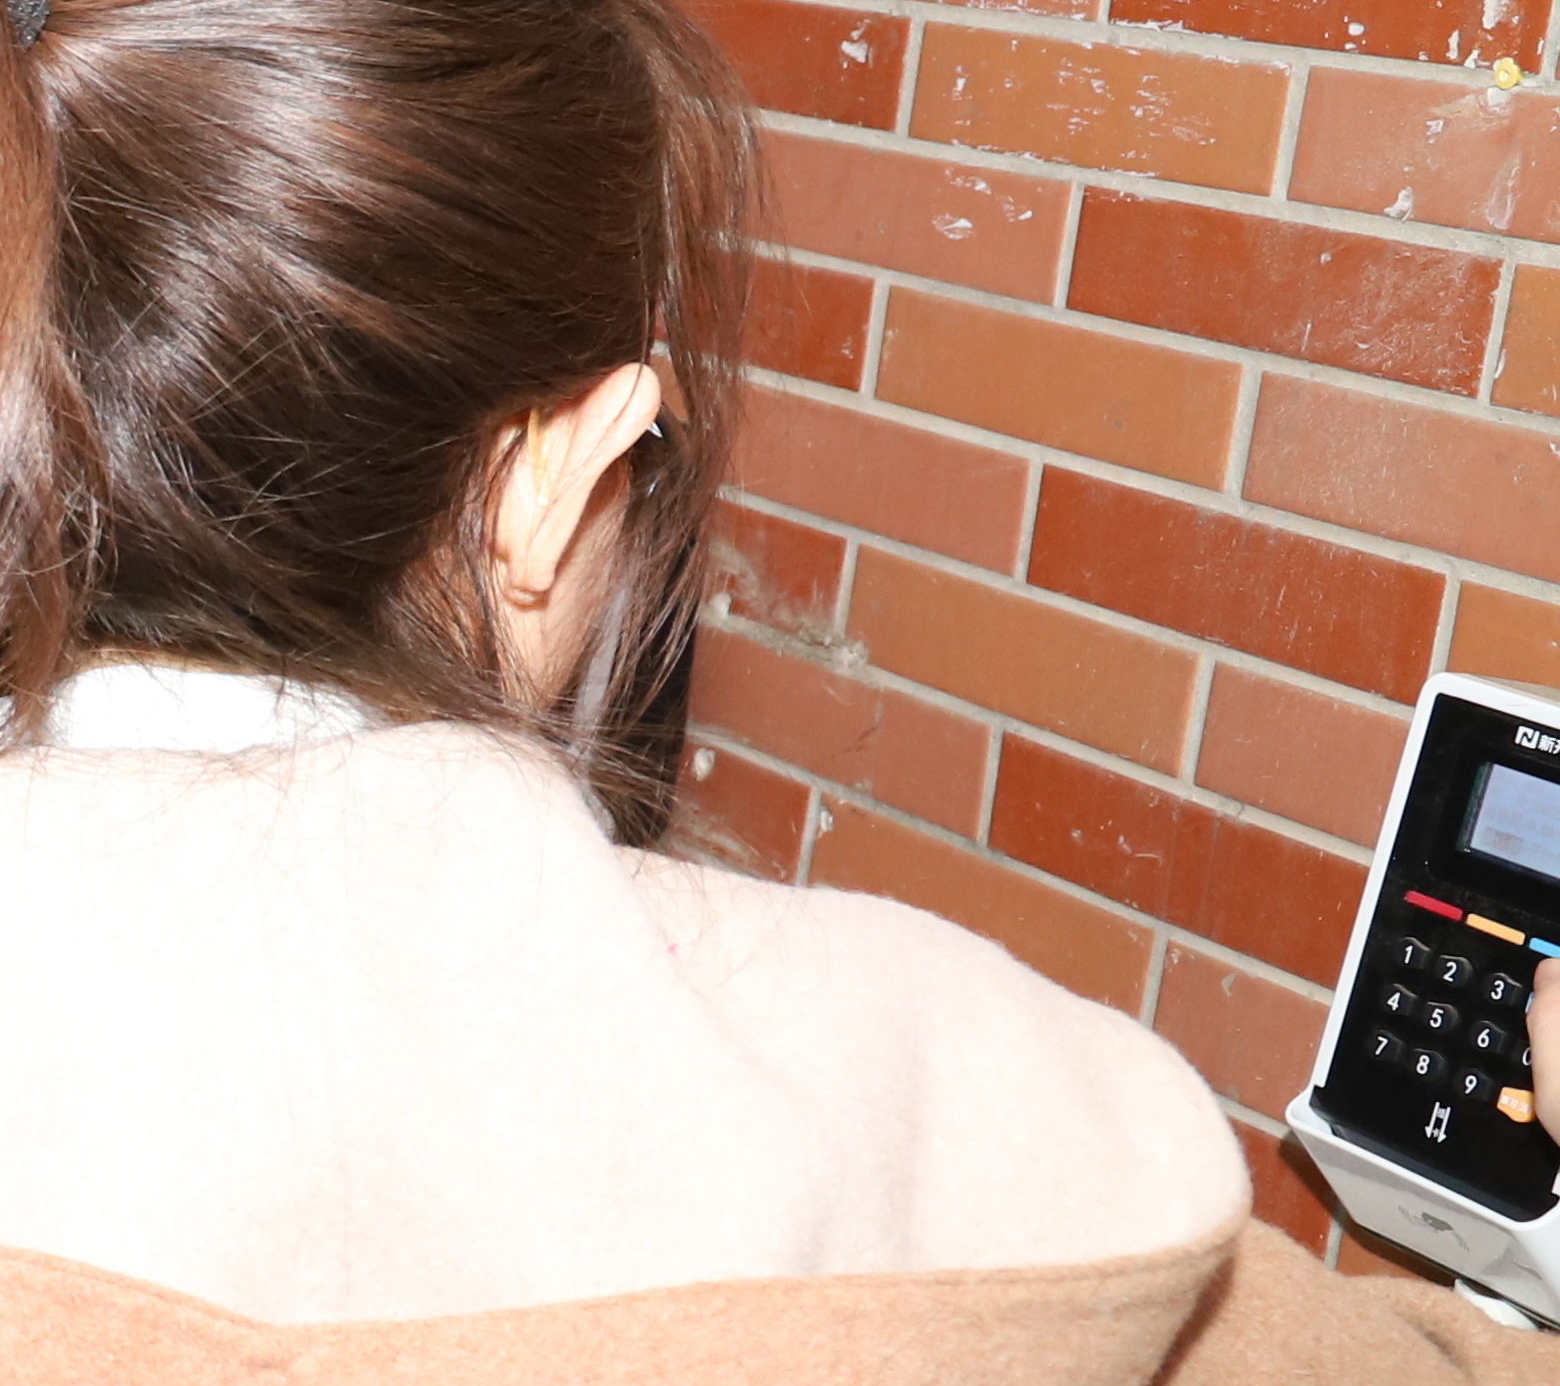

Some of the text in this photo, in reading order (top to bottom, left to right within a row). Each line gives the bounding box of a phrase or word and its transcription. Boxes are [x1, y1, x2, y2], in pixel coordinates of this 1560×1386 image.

[1403, 944, 1506, 1001] 1 2 3
[1386, 991, 1401, 1012] 4
[1429, 1008, 1444, 1029] 5
[1476, 1028, 1490, 1049] 6
[1375, 1036, 1477, 1095] 7 8 9
